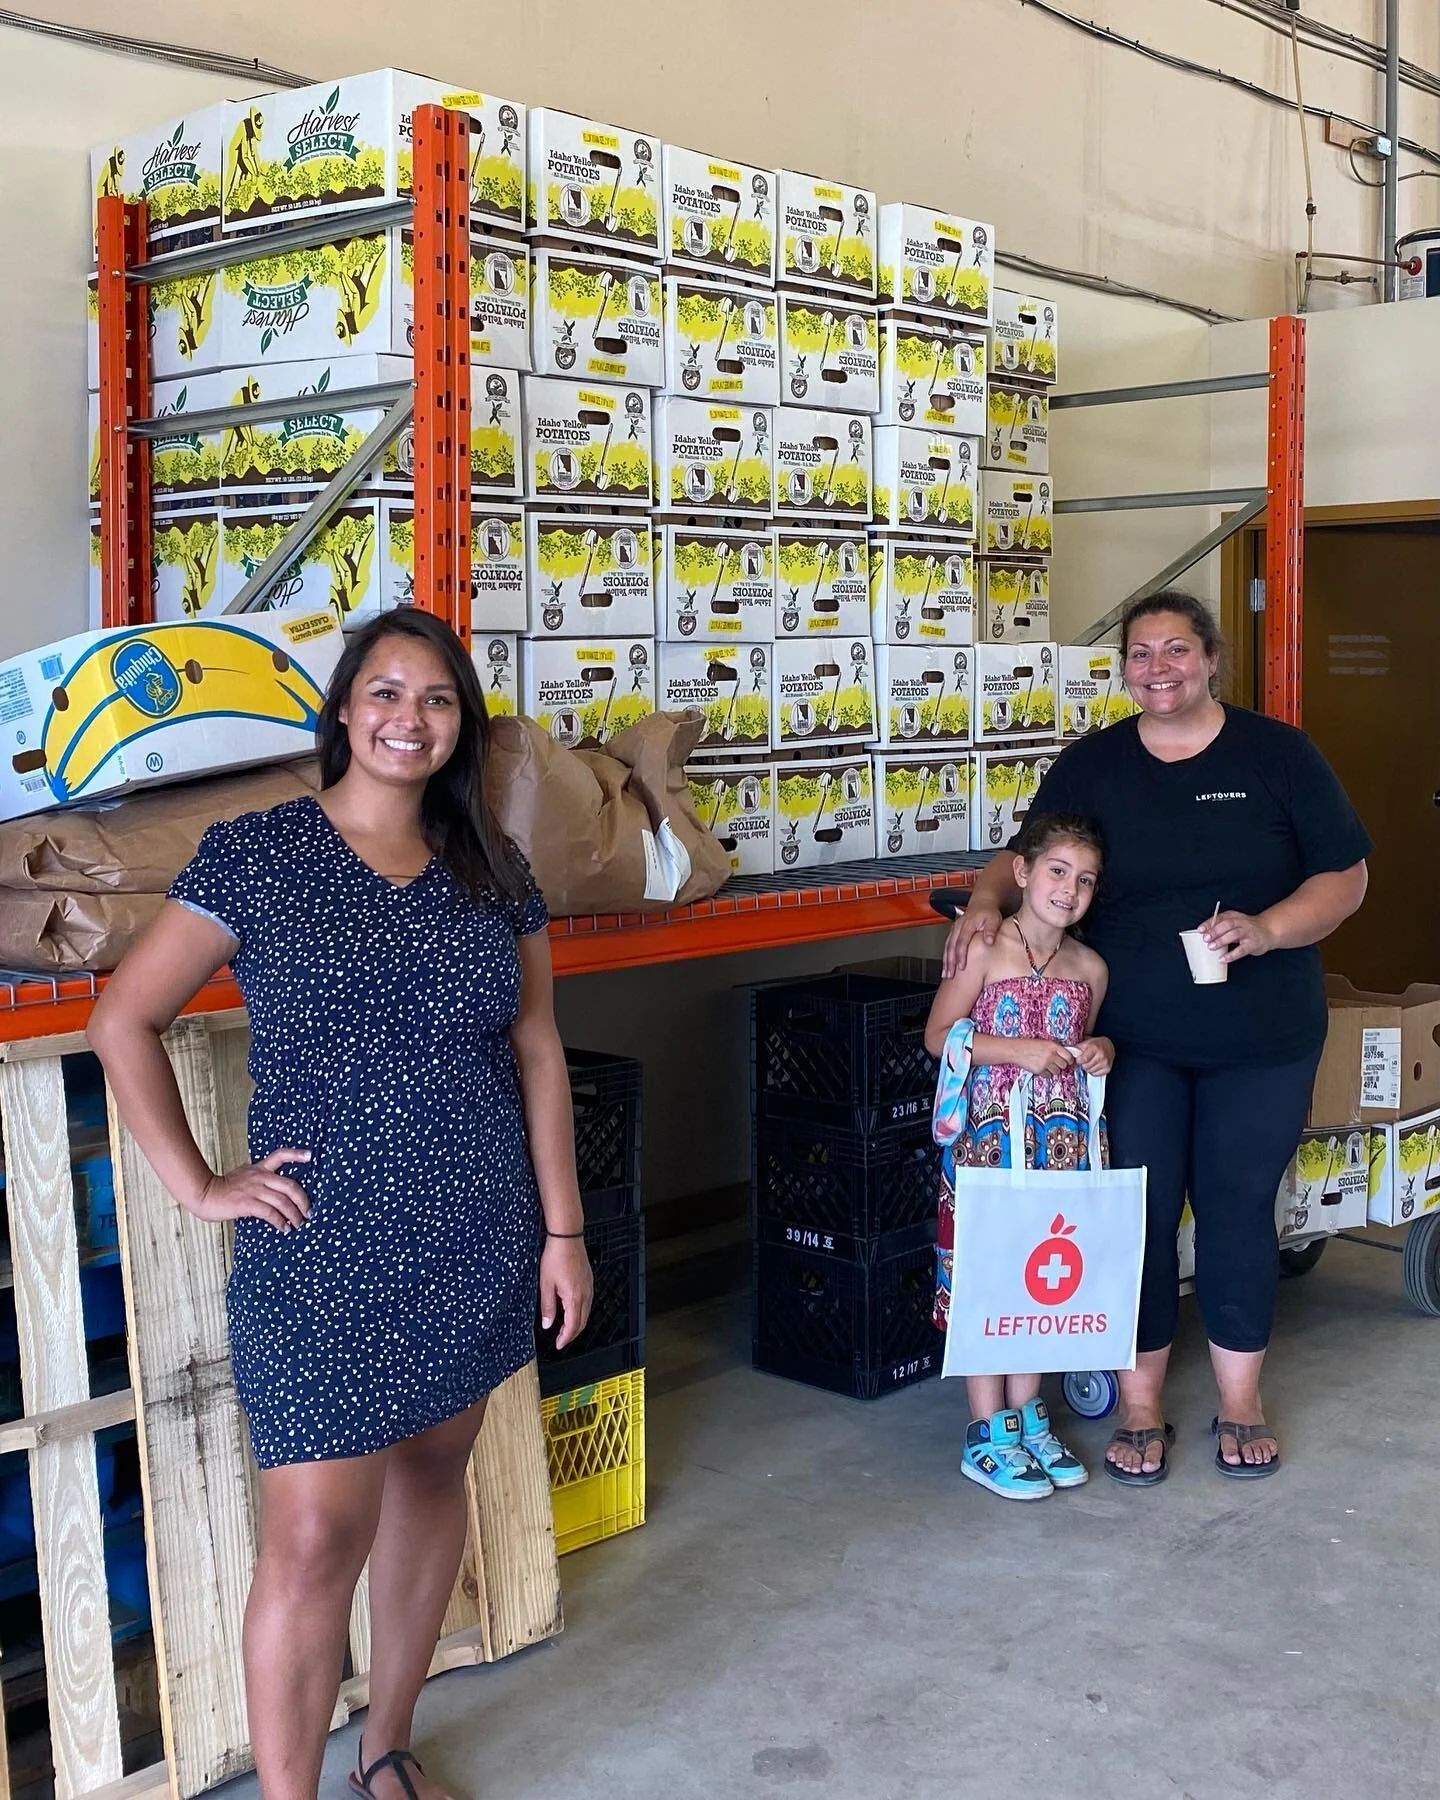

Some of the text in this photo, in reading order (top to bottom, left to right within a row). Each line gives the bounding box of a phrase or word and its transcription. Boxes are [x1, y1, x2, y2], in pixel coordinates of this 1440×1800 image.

[287, 109, 361, 144] Harvest
[294, 134, 347, 157] SELECT
[142, 141, 202, 177] Harvest
[549, 149, 573, 162] Idaho
[147, 165, 192, 188] SELECT
[547, 160, 600, 181] POTATOES
[674, 184, 695, 196] Idaho
[672, 194, 721, 214] POTATOES
[786, 206, 804, 217] Idaho
[785, 214, 828, 232] POTATOES
[906, 237, 924, 248] Idaho
[904, 246, 945, 264] POTATOES
[252, 289, 302, 310] SELECT
[474, 300, 526, 319] POTATOES
[242, 302, 310, 335] Harvest
[504, 317, 525, 330] Idaho
[618, 322, 660, 338] POTATOES
[995, 326, 1024, 338] POTATOES
[641, 336, 659, 348] Idaho
[736, 344, 776, 360] POTATOES
[838, 354, 876, 370] POTATOES
[947, 382, 984, 394] POTATOES
[288, 414, 338, 432] SELECT
[537, 418, 560, 427] Idaho
[536, 428, 590, 441] POTATOES
[674, 434, 696, 444] Idaho
[672, 444, 723, 456] POTATOES
[779, 441, 798, 450] Idaho
[778, 450, 822, 463] POTATOES
[902, 460, 917, 470] Idaho
[900, 469, 936, 482] POTATOES
[988, 508, 1020, 516] POTATOES
[498, 582, 521, 590] Idaho
[602, 576, 650, 588] POTATOES
[627, 586, 648, 597] Idaho
[732, 587, 773, 598] POTATOES
[832, 584, 867, 594] POTATOES
[938, 596, 972, 604] POTATOES
[115, 646, 162, 690] Chiquita
[669, 680, 692, 688] Idaho
[782, 674, 800, 682] Idaho
[540, 680, 564, 690] Idaho
[780, 682, 824, 693] POTATOES
[983, 682, 1020, 692] POTATOES
[1064, 686, 1098, 696] POTATOES
[538, 688, 593, 701] POTATOES
[666, 688, 719, 698] POTATOES
[891, 687, 929, 696] POTATOES
[1196, 792, 1246, 801] LEFTOVERS
[932, 802, 967, 814] POTATOES
[834, 808, 871, 822] POTATOES
[728, 819, 770, 832] POTATOES
[984, 1313, 1108, 1337] LEFTOVERS
